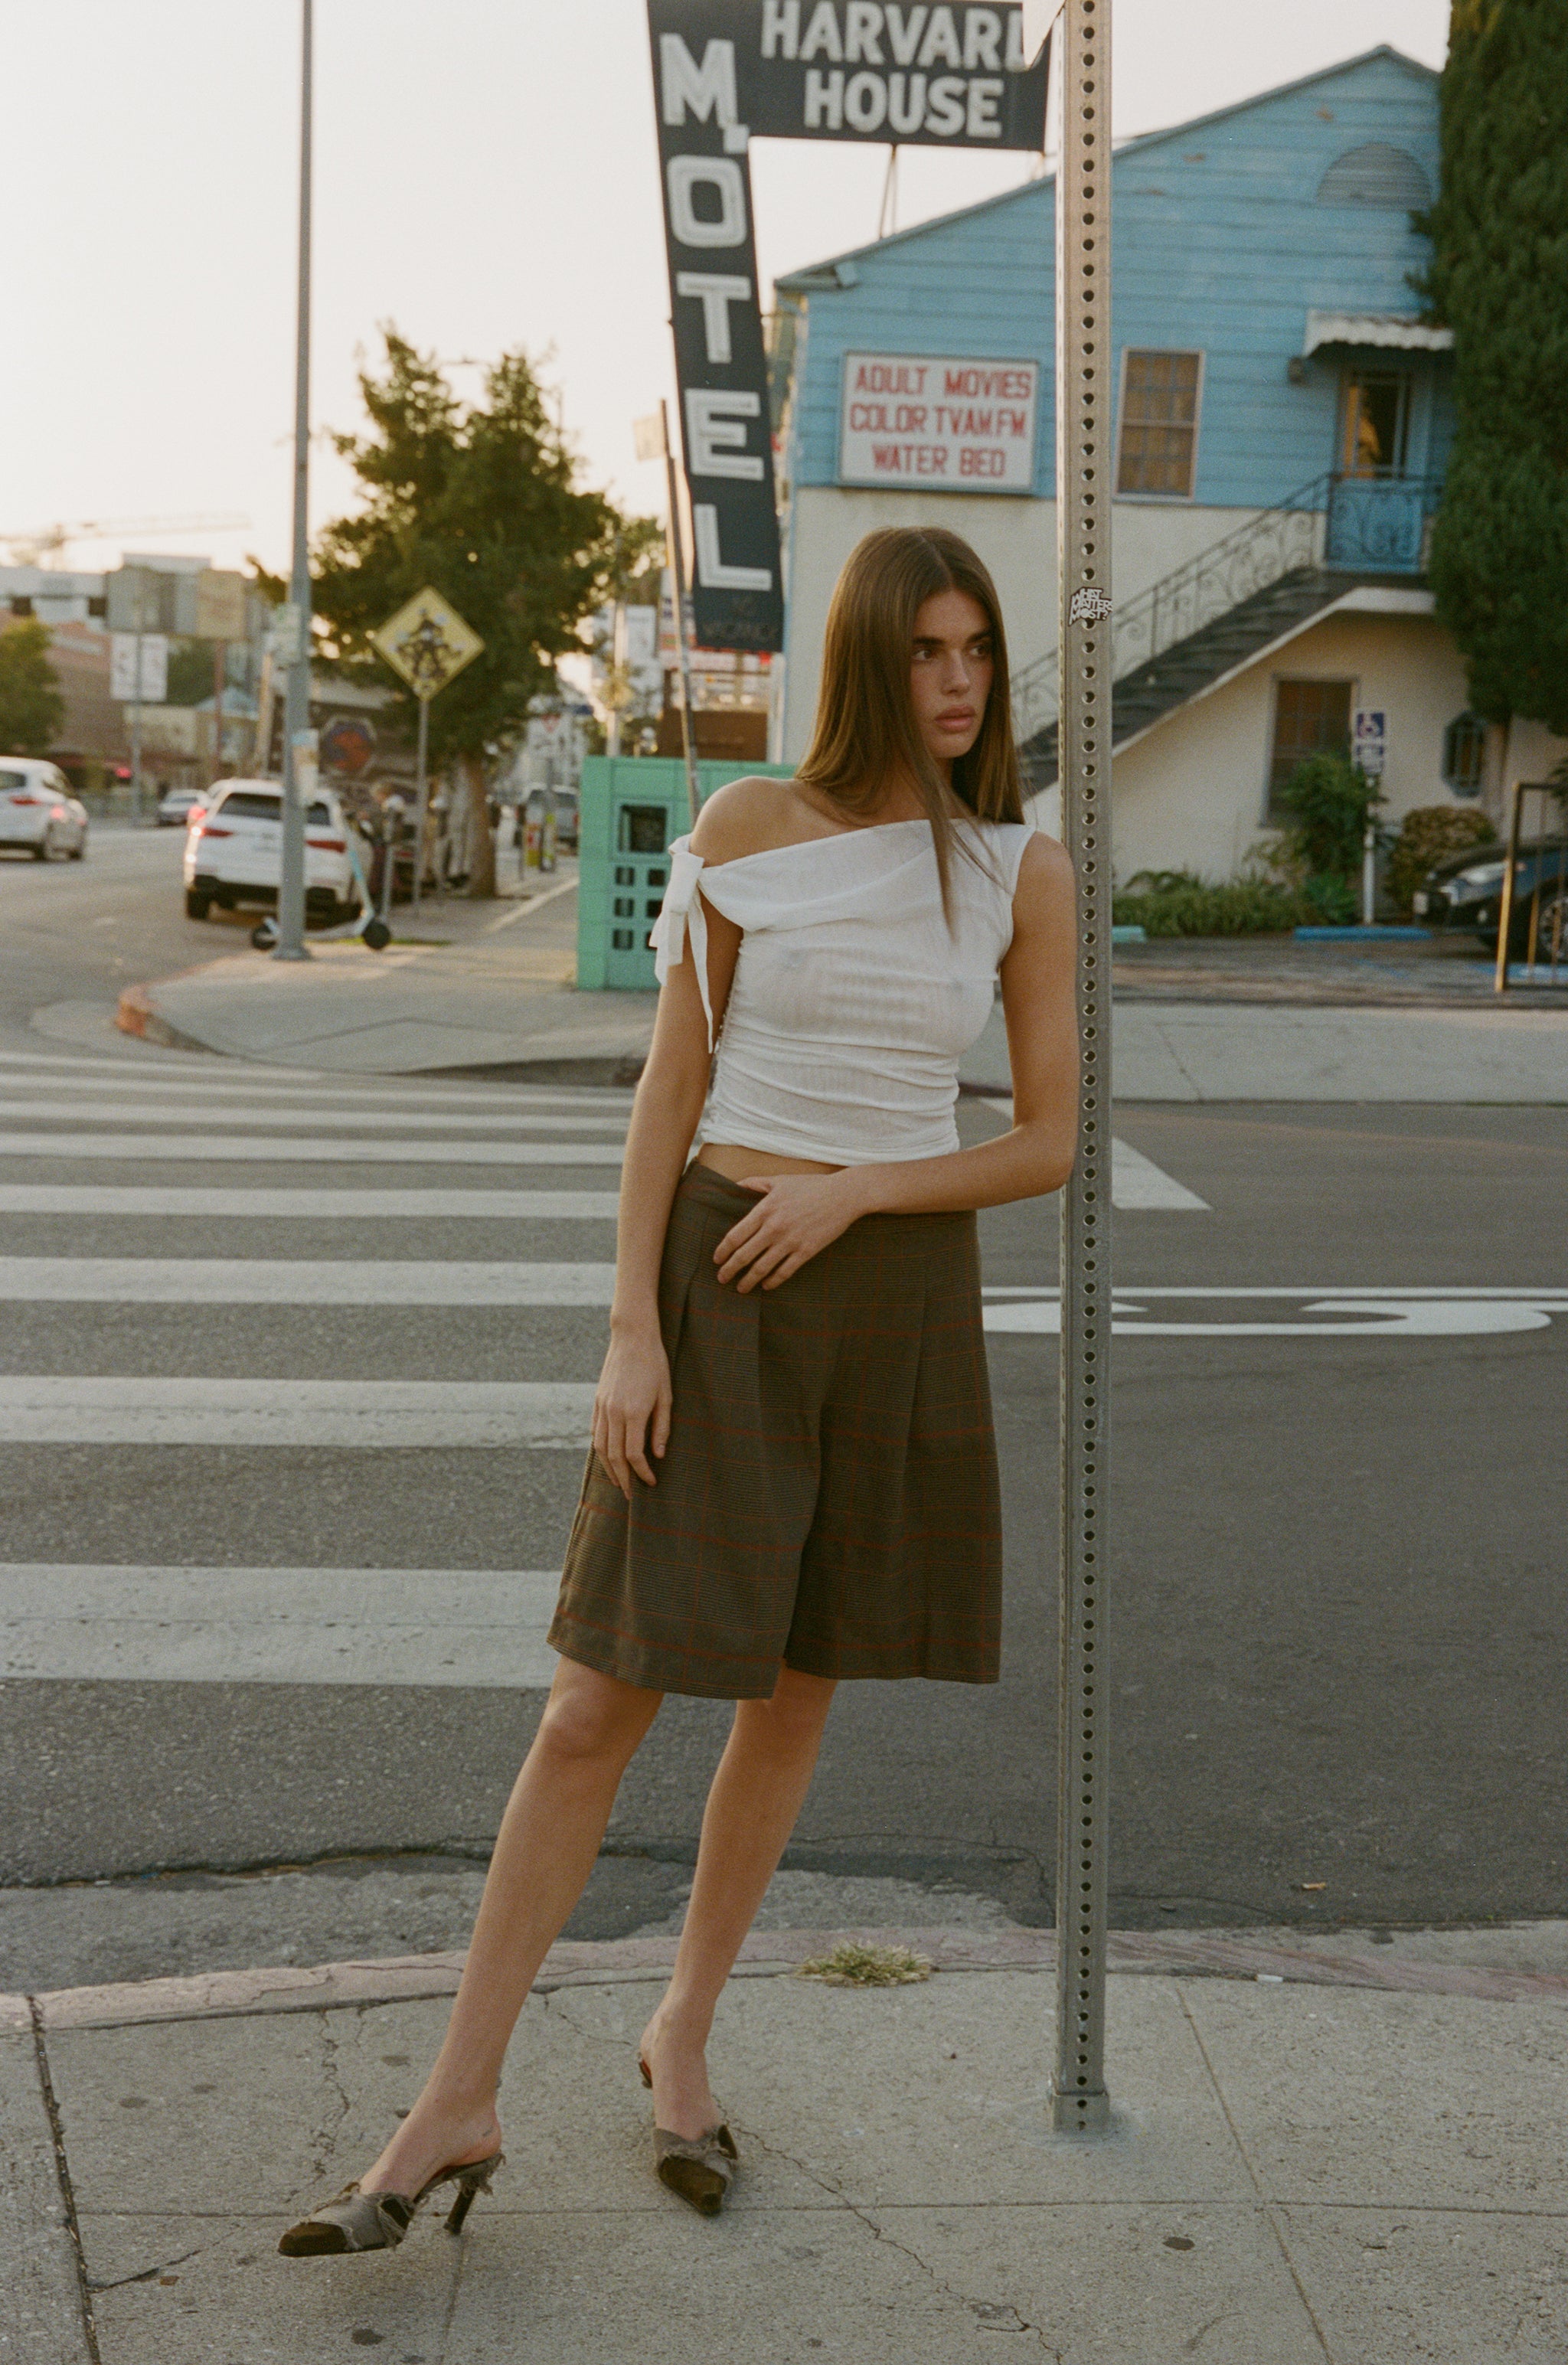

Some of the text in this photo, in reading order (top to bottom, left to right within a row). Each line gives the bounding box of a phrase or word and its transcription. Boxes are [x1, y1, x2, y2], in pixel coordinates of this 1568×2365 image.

[803, 68, 1004, 139] HOUSE
[658, 33, 773, 592] MOTEL
[854, 364, 1031, 400] ADULT MOVIES
[849, 403, 927, 434] COLOR
[871, 444, 1007, 477] WATER BED
[1072, 588, 1102, 607] WHAT
